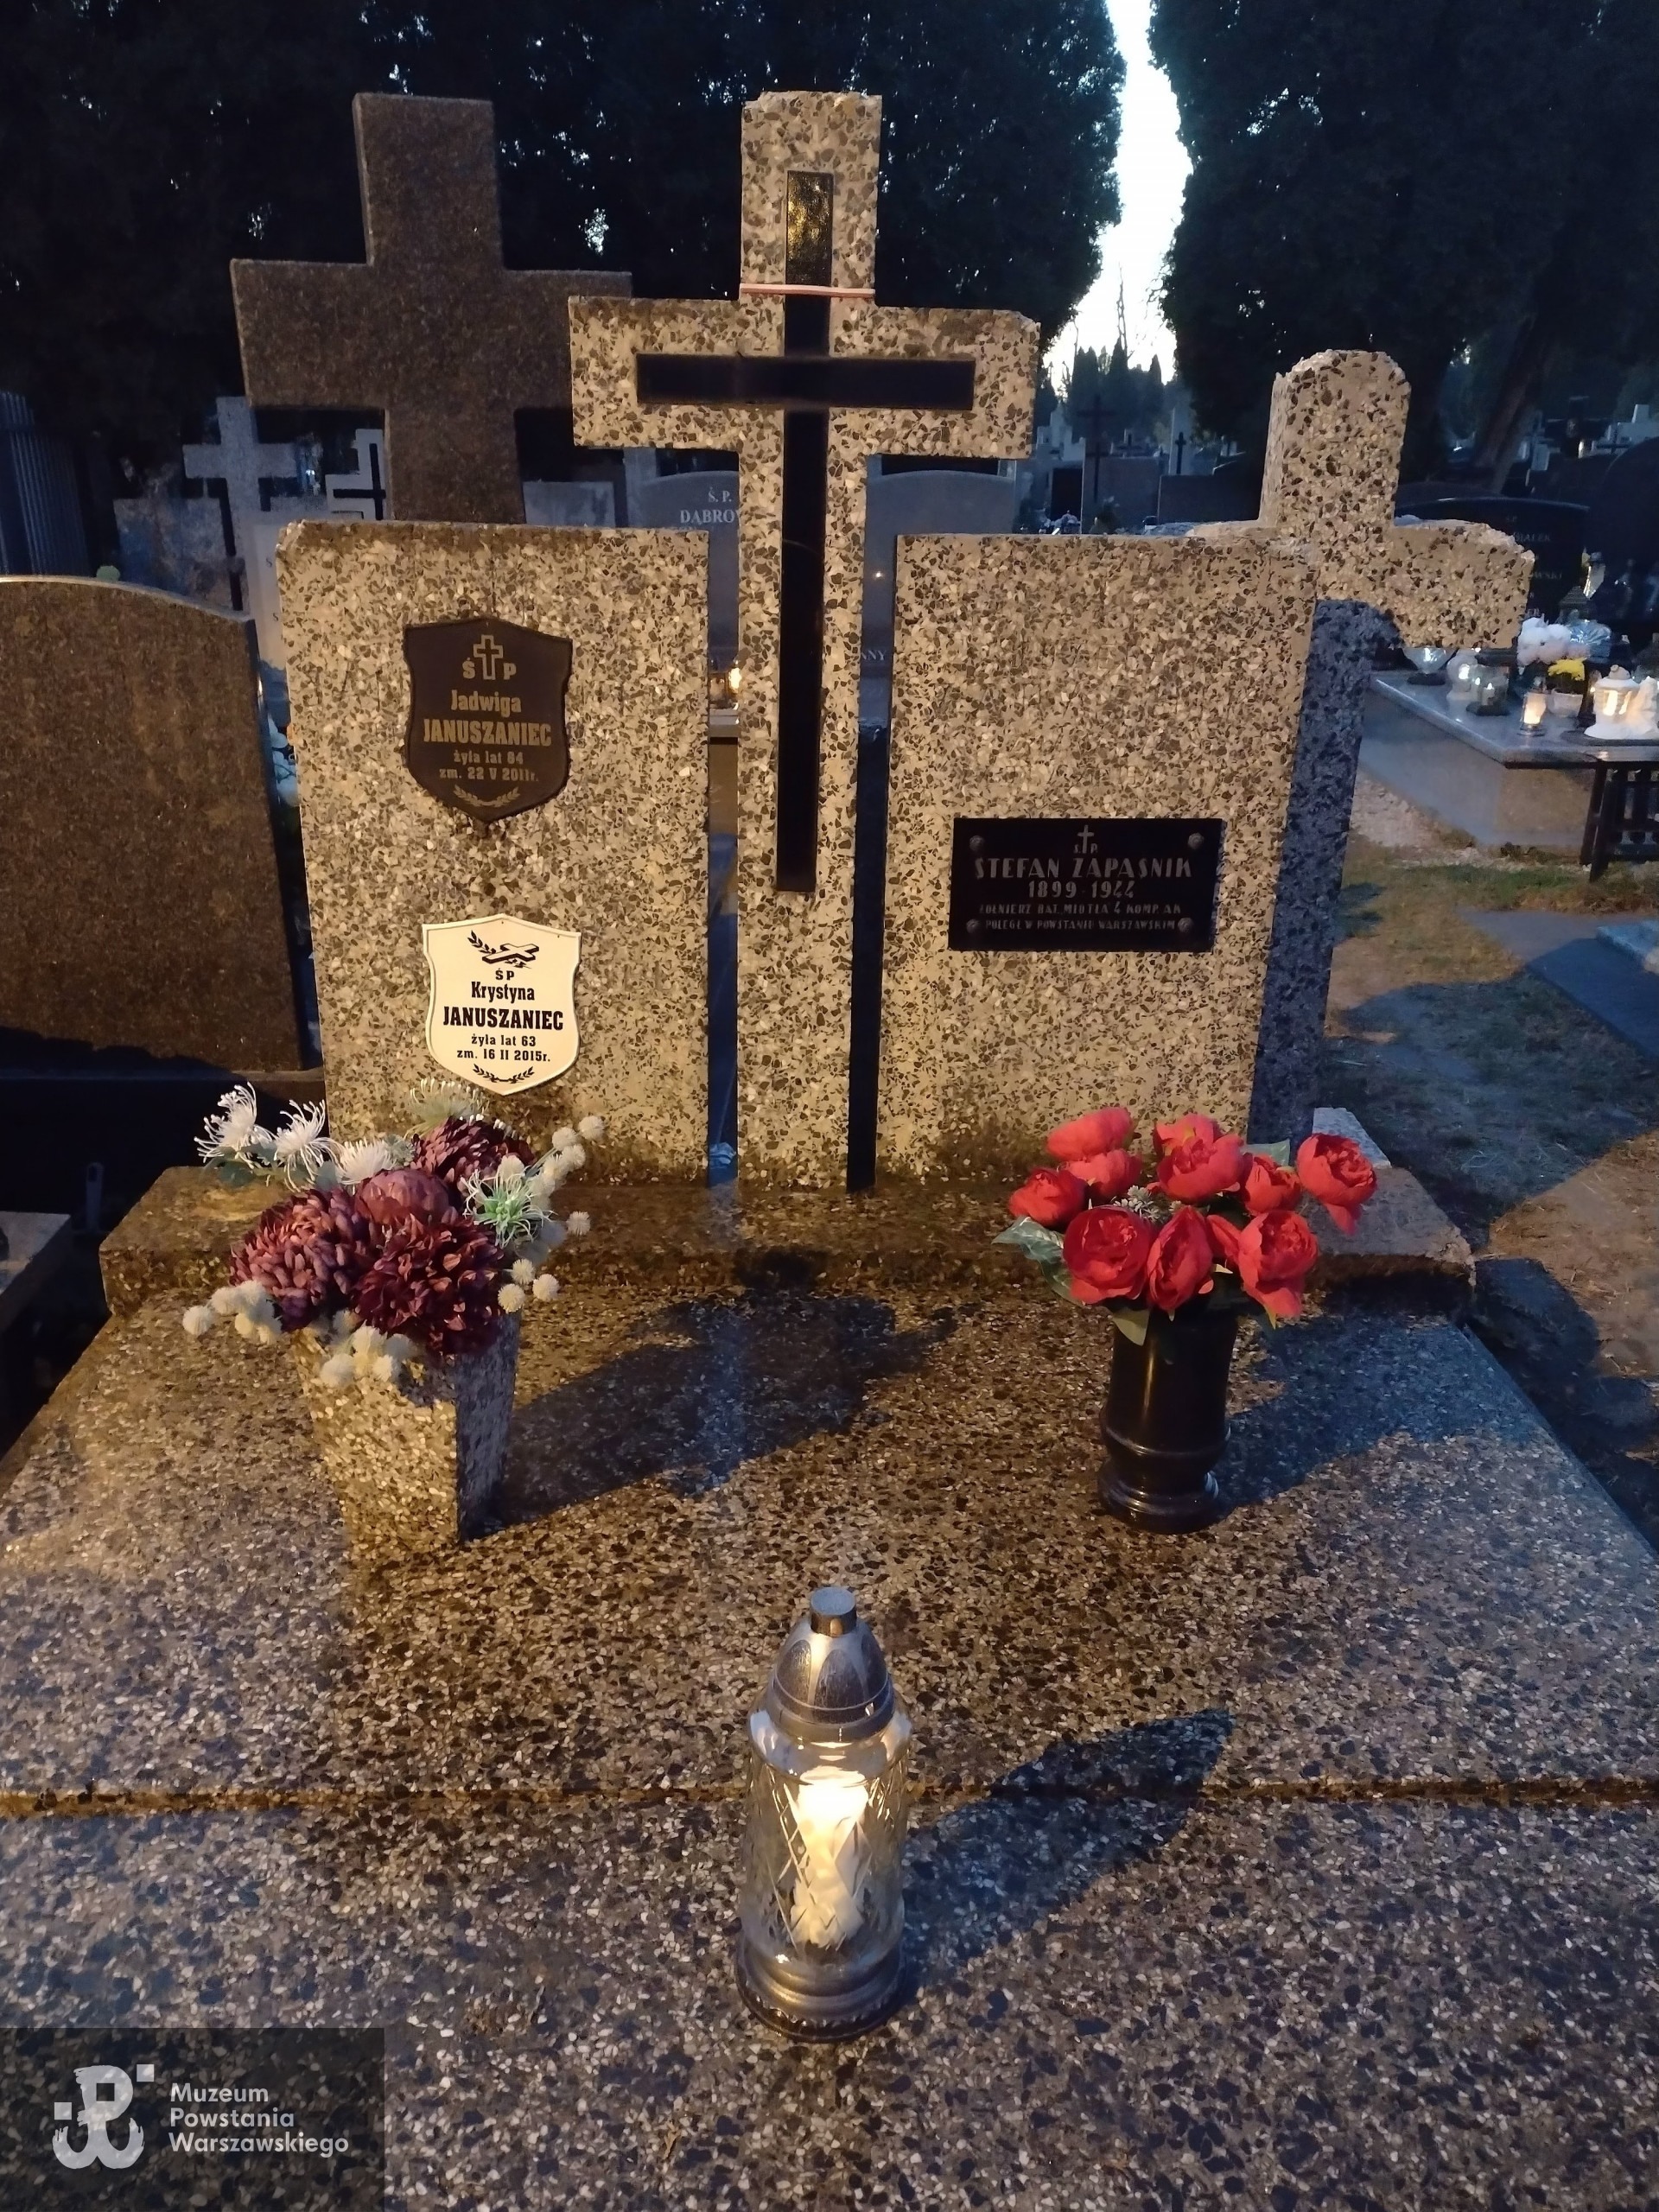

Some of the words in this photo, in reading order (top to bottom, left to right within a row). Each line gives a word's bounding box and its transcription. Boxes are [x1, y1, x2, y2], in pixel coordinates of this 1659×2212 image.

[504, 663, 517, 680] P
[451, 690, 522, 717] Jadwiga
[423, 718, 552, 747] JANUSZANIEC
[454, 749, 480, 766] żyła
[485, 750, 502, 764] lat
[439, 768, 462, 779] zm.
[467, 766, 484, 780] 22
[489, 767, 497, 780] V
[975, 856, 1059, 879] STEFAN
[1028, 880, 1077, 898] 1899
[1091, 880, 1135, 898] 1944
[1114, 900, 1121, 914] 4
[1163, 903, 1181, 914] AK
[1024, 919, 1033, 930] W
[1098, 919, 1176, 930] WARSZAWSKIM
[506, 970, 514, 981] P
[471, 982, 535, 1003] Krystyna
[443, 1006, 563, 1031] JANUSZANIEC
[471, 1033, 496, 1046] żyła
[501, 1035, 516, 1046] lat
[521, 1036, 536, 1046] 63
[457, 1050, 478, 1059] zm.
[483, 1048, 495, 1059] 16
[514, 1050, 550, 1062] 2015r.
